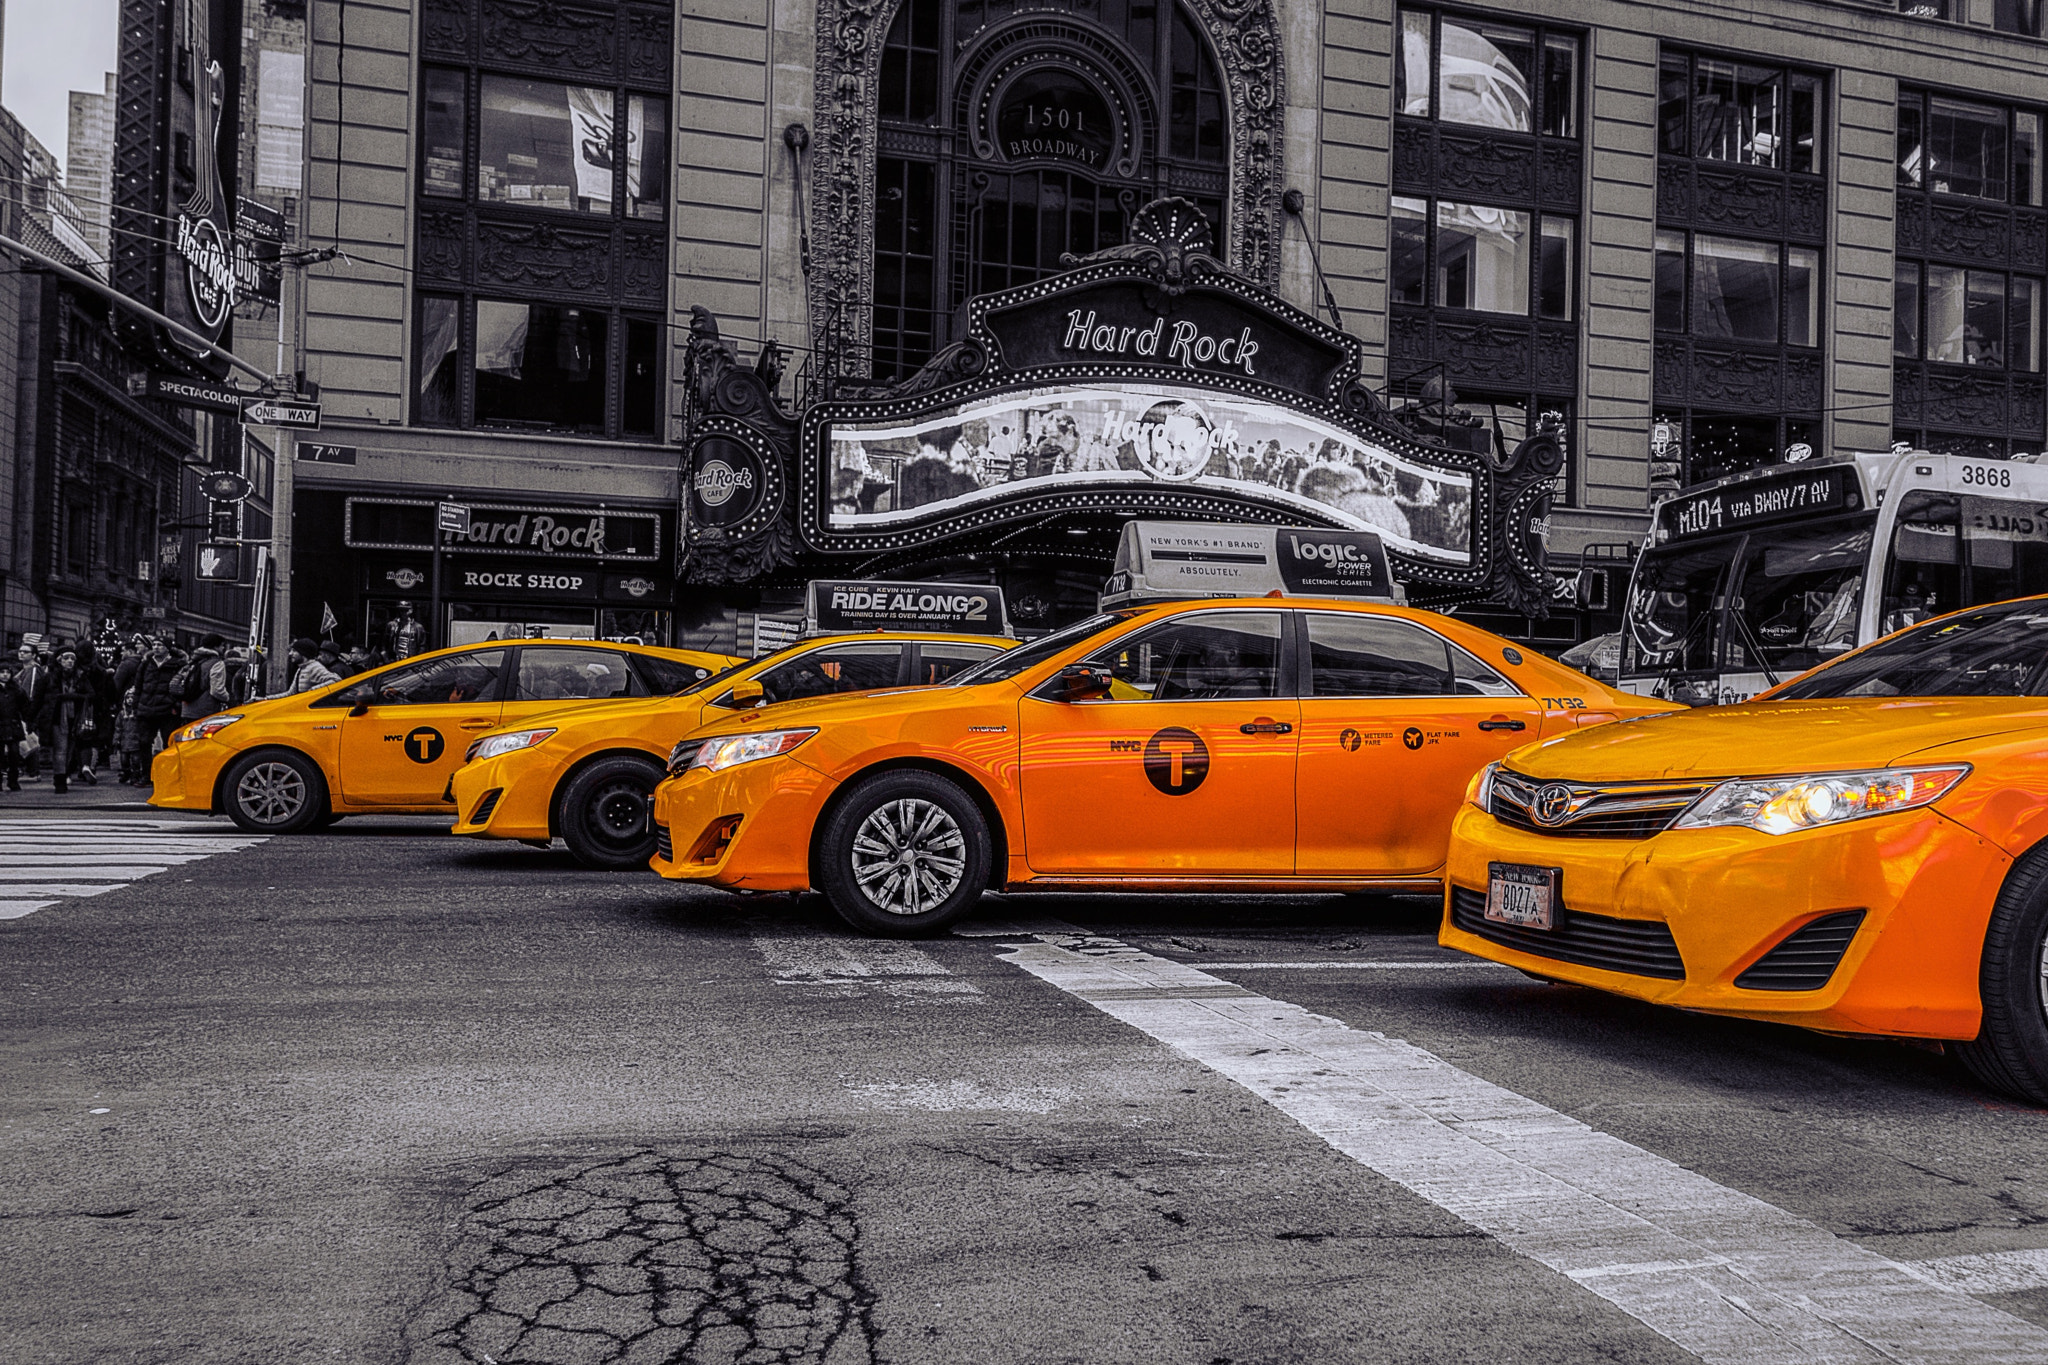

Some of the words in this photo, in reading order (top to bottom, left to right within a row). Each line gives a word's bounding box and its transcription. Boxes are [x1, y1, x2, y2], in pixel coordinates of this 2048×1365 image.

[1028, 105, 1084, 131] 1501
[1010, 139, 1099, 164] BROADWAY
[177, 214, 210, 275] Hard
[208, 242, 236, 305] Rock
[1064, 309, 1164, 356] Hard
[1168, 320, 1259, 374] Rock
[159, 380, 239, 406] SPECTACOLOR
[255, 406, 277, 419] ONE
[288, 408, 312, 421] WAY
[312, 445, 324, 461] 7
[327, 447, 341, 456] AV
[715, 467, 752, 490] Rock
[1962, 465, 2011, 488] 3868
[1679, 496, 1723, 534] M104
[1731, 502, 1751, 518] VIA
[1754, 484, 1806, 514] BWAY/7
[1811, 479, 1829, 503] AV
[444, 514, 528, 545] ard
[531, 515, 605, 554] Rock
[1150, 537, 1172, 545] NEW
[1175, 539, 1208, 547] YORK'S
[1290, 534, 1368, 568] logic.
[1179, 566, 1241, 577] ABSOLUTELY.
[1337, 562, 1372, 570] POWER
[464, 571, 522, 588] ROCK
[527, 574, 583, 590] SHOP
[1302, 578, 1339, 586] ELECTRONIC
[1340, 579, 1373, 587] CIGARETTE
[831, 592, 888, 610] RIDE
[888, 593, 969, 613] ALONG
[964, 596, 988, 621] 2
[1541, 697, 1587, 709] 7Y32
[413, 733, 436, 759] T
[1110, 741, 1142, 752] NYC
[1158, 741, 1195, 787] T
